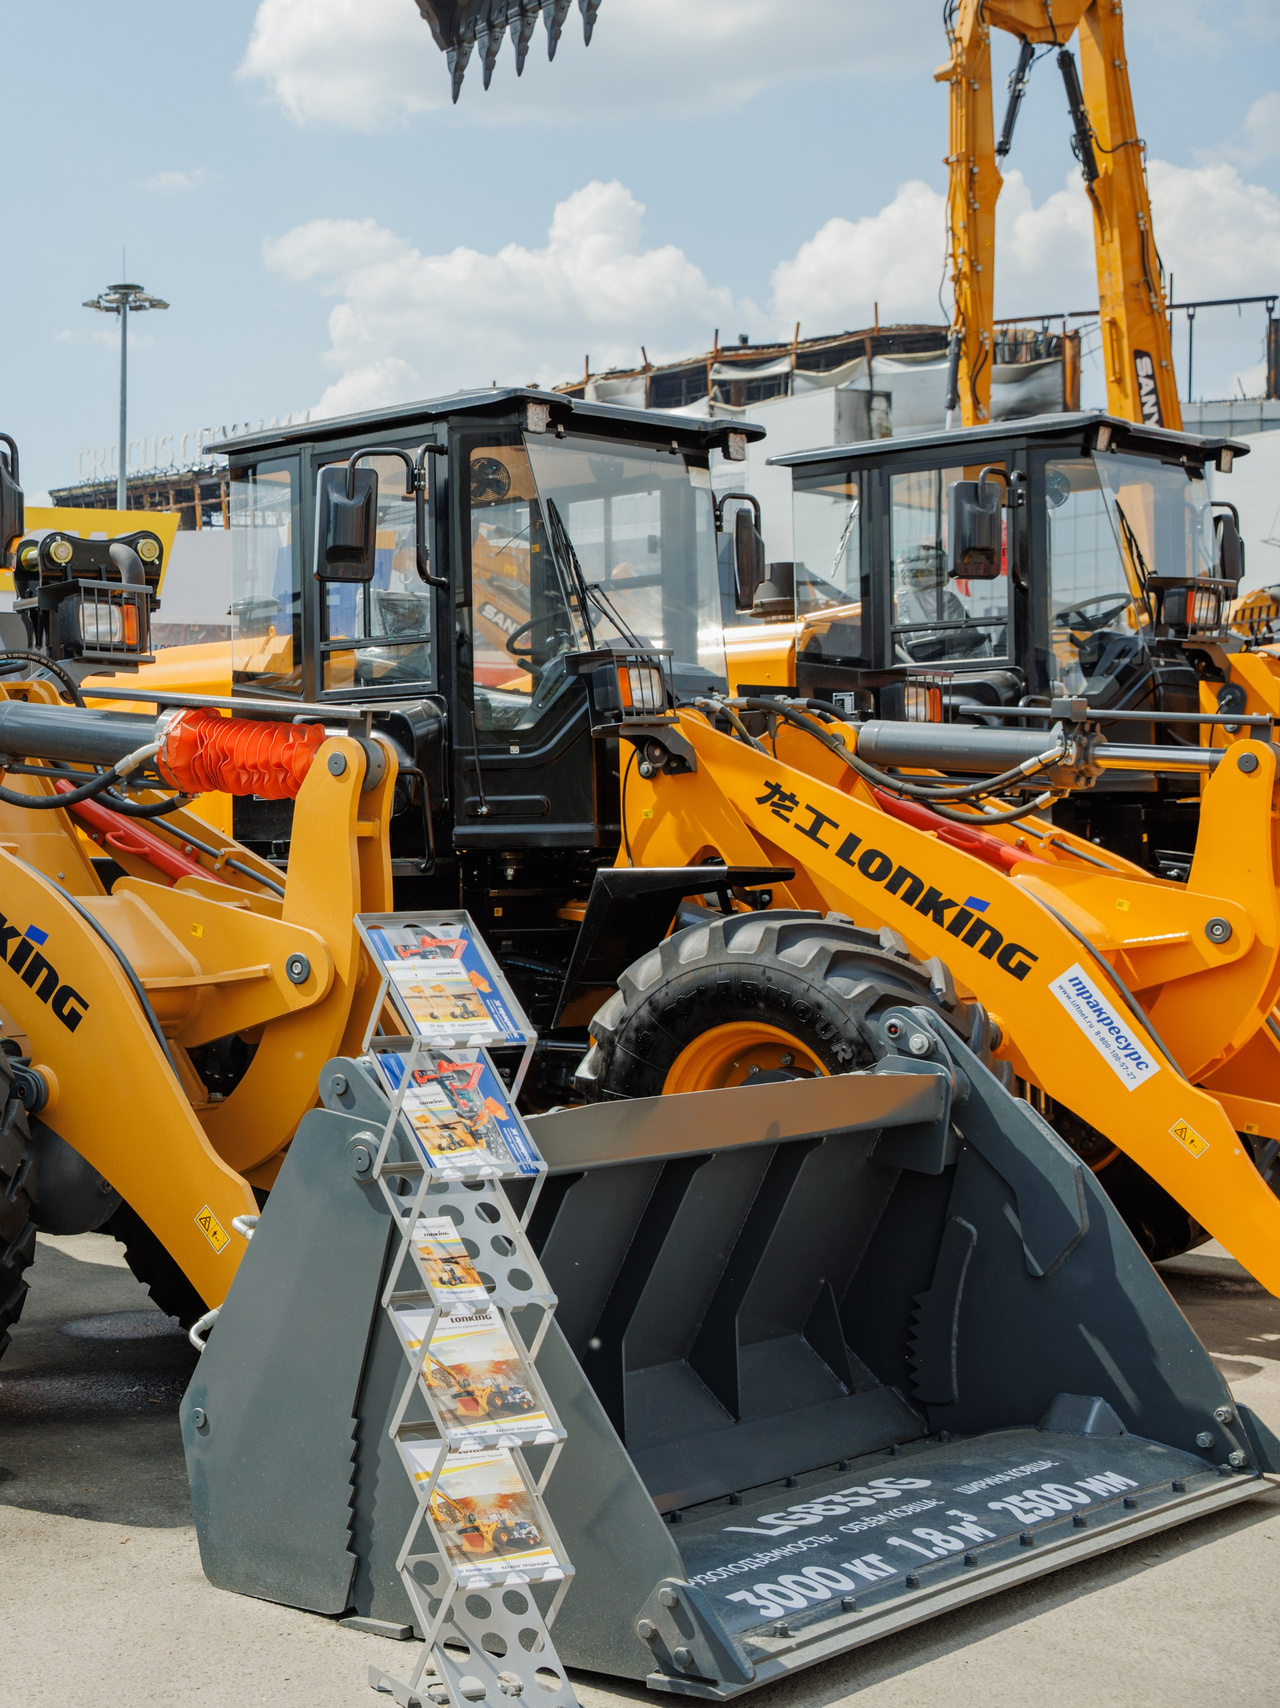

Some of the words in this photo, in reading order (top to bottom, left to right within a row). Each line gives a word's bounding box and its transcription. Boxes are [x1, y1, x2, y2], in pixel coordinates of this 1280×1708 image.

[76, 433, 174, 480] CROCUS
[1058, 984, 1094, 1029] www.liftnet.ru
[1095, 1031, 1137, 1080] 8-800-100-57-27
[722, 1477, 932, 1536] LG833G
[953, 1473, 1011, 1495] ШИРИНА
[988, 1483, 1091, 1524] 2500
[839, 1511, 892, 1534] ОБЪЁМ
[725, 1566, 855, 1618] 3000
